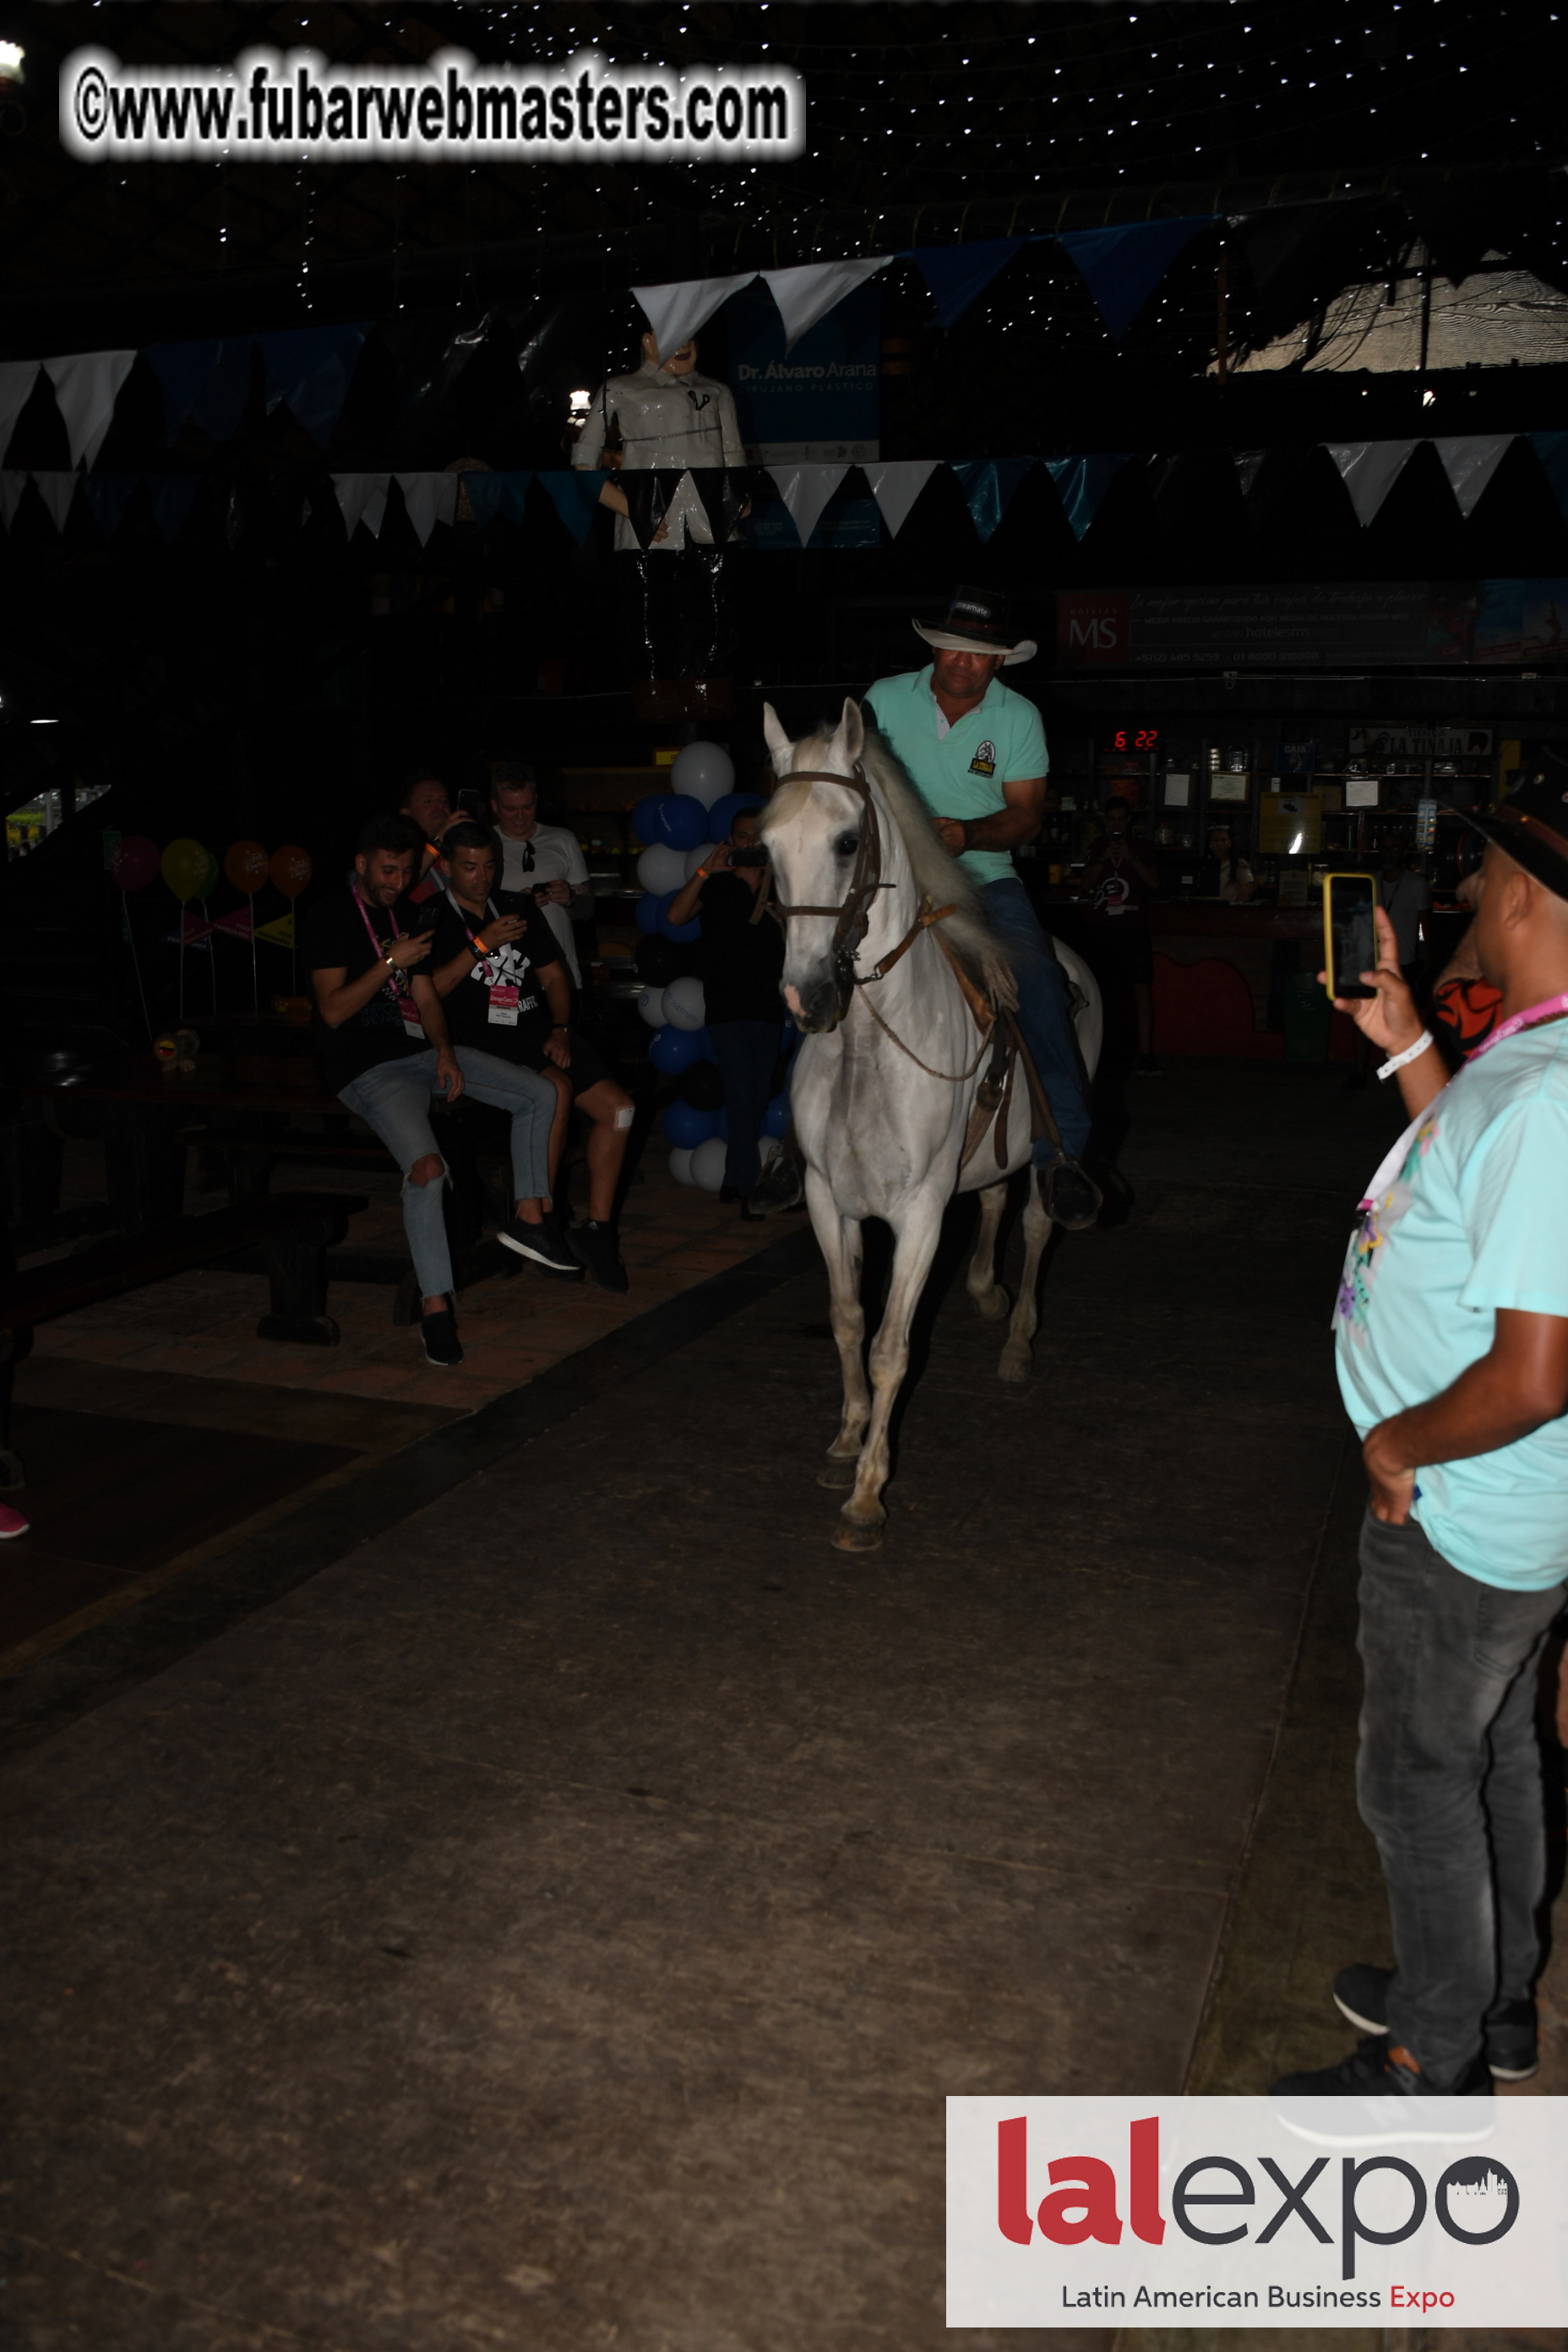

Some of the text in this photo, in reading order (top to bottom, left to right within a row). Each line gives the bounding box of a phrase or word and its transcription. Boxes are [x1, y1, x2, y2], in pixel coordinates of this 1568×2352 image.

[956, 602, 988, 617] streamate
[1130, 593, 1144, 609] La
[1147, 596, 1180, 612] mejor
[1219, 599, 1250, 612] para
[1144, 617, 1170, 625] MEJOR
[1202, 615, 1258, 623] GARANTIZADO
[1260, 614, 1277, 623] POR
[1069, 618, 1118, 650] MS
[1170, 652, 1190, 662] 485
[1193, 652, 1220, 662] 5259
[1248, 651, 1277, 661] 8000
[1390, 738, 1463, 754] LA TINAJA
